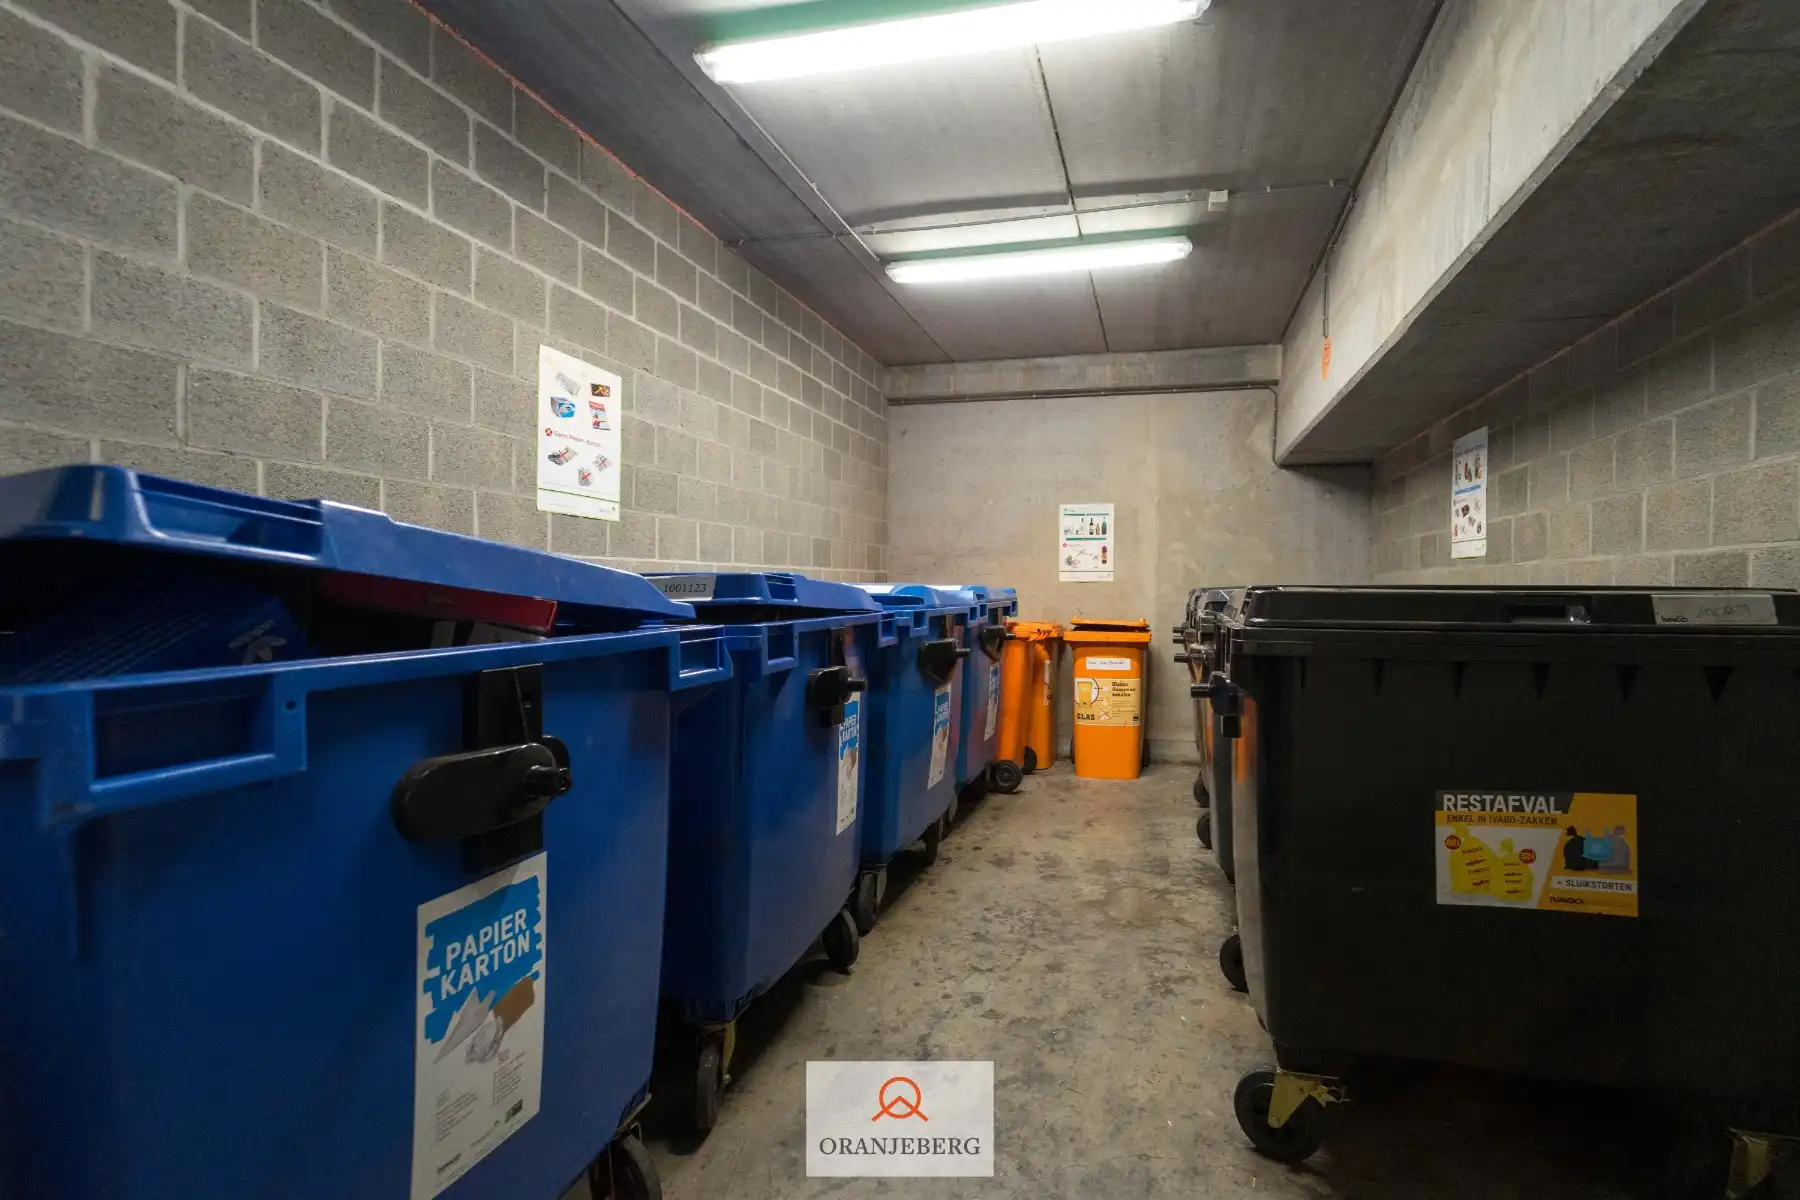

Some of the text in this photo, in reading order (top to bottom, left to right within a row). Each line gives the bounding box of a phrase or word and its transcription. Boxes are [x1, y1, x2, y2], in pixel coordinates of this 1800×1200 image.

[663, 583, 707, 593] 1001123
[1443, 794, 1562, 814] RESTAFVAL
[1447, 814, 1474, 823] ENKEL
[1478, 815, 1486, 823] IN
[1565, 879, 1632, 891] SLUIKSTORTEN
[446, 908, 527, 971] PAPIER
[441, 929, 530, 1001] KARTON
